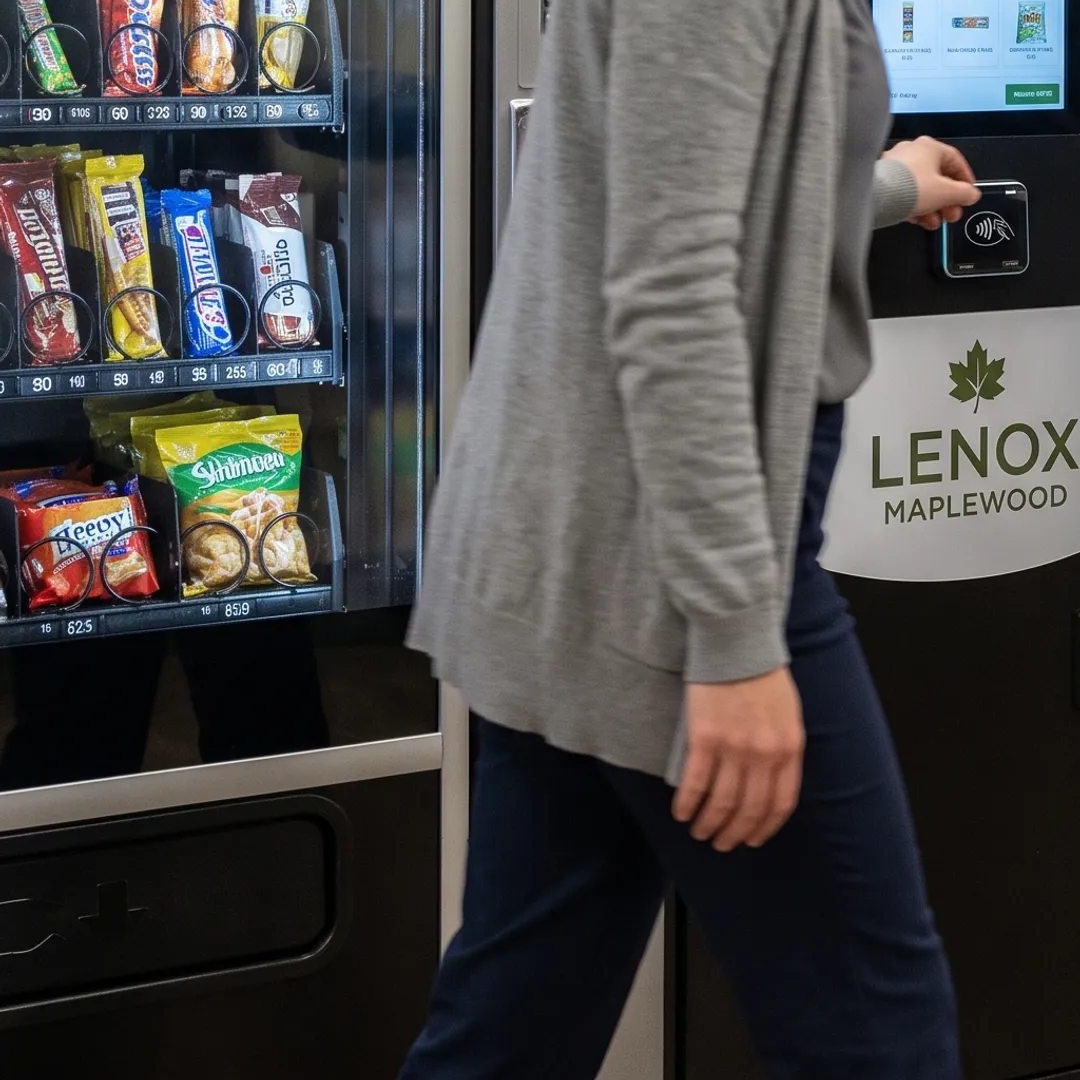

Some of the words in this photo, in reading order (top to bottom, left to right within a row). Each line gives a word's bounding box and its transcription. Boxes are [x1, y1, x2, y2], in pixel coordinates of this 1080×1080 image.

[225, 366, 247, 379] 255
[872, 418, 1079, 489] LENOX
[884, 484, 1068, 525] MAPLEWOOD
